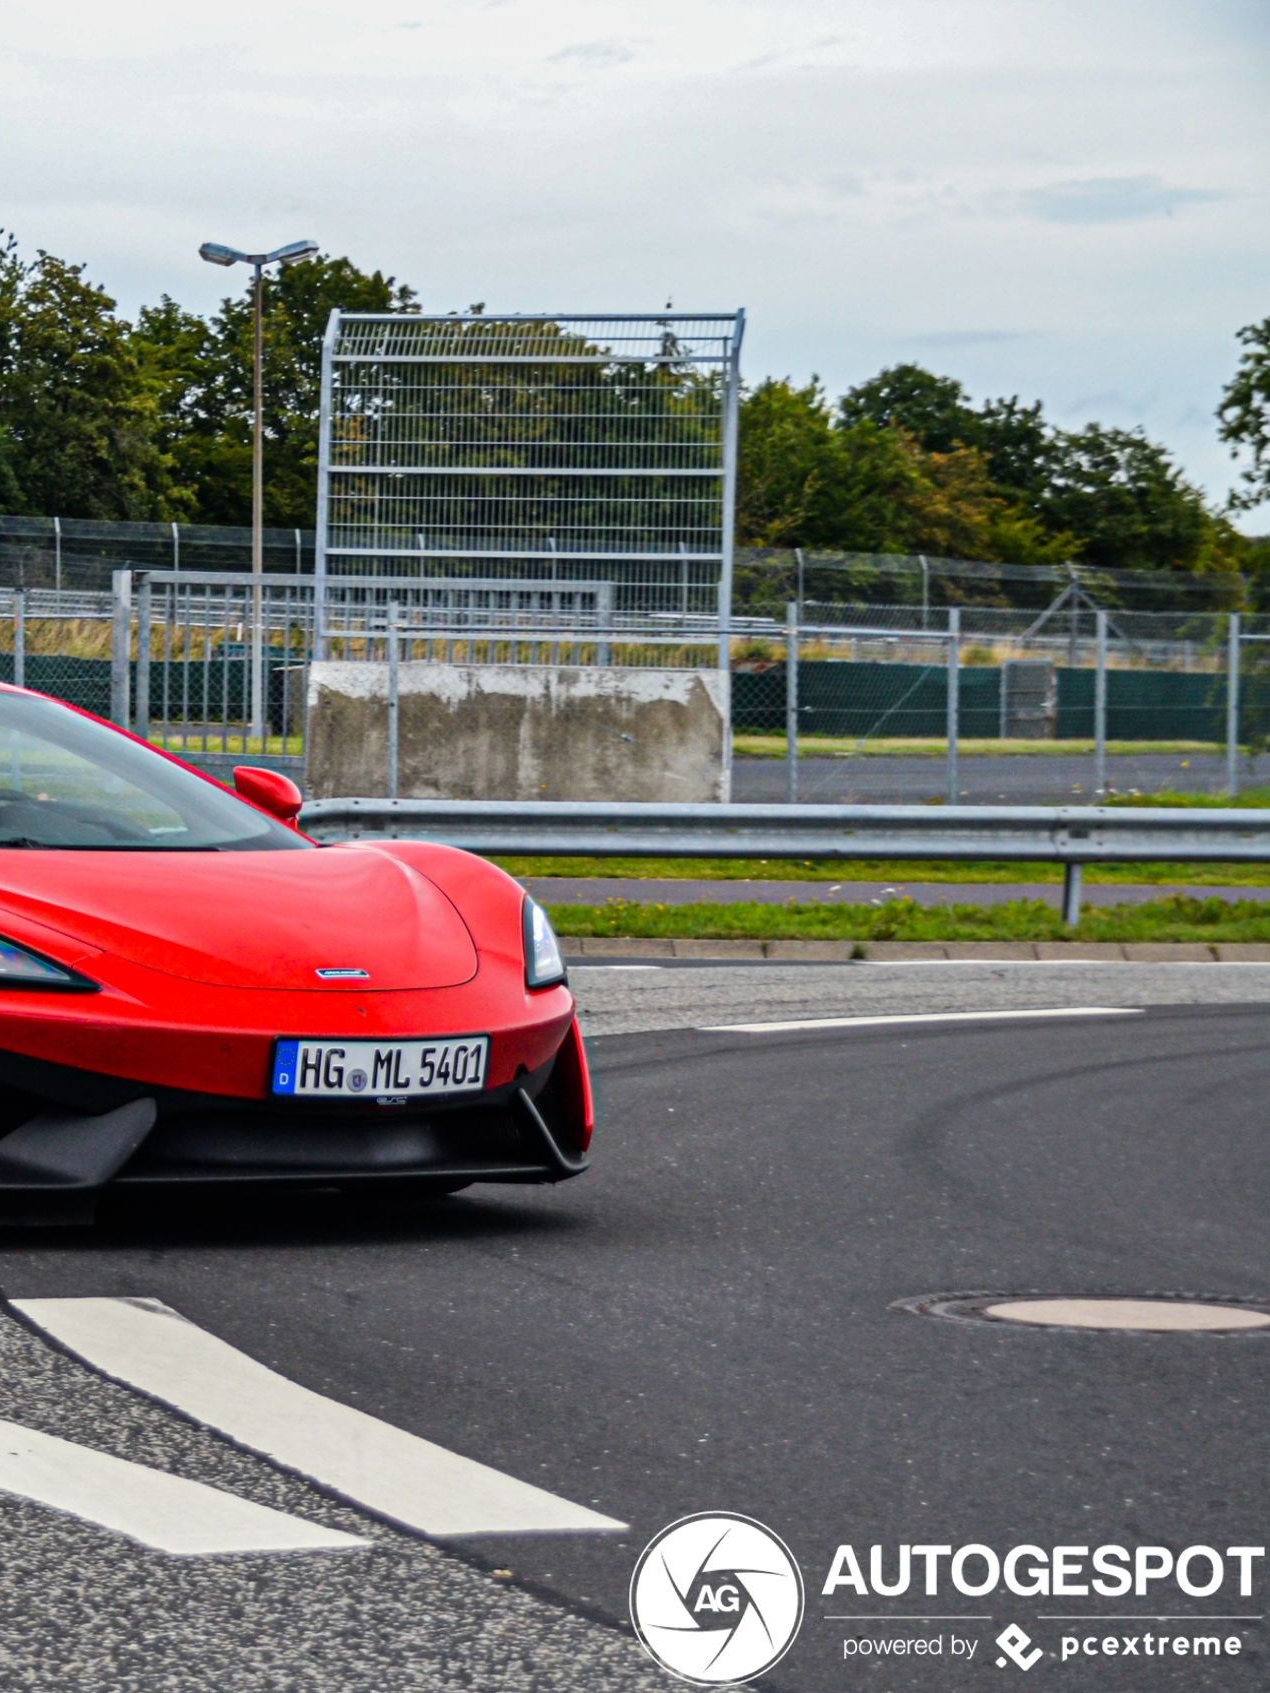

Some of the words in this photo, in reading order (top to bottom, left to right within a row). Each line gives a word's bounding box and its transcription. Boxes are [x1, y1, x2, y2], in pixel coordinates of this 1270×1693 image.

[279, 1073, 289, 1085] D
[299, 1048, 345, 1088] HG
[372, 1049, 410, 1089] ML
[419, 1044, 482, 1087] 5401
